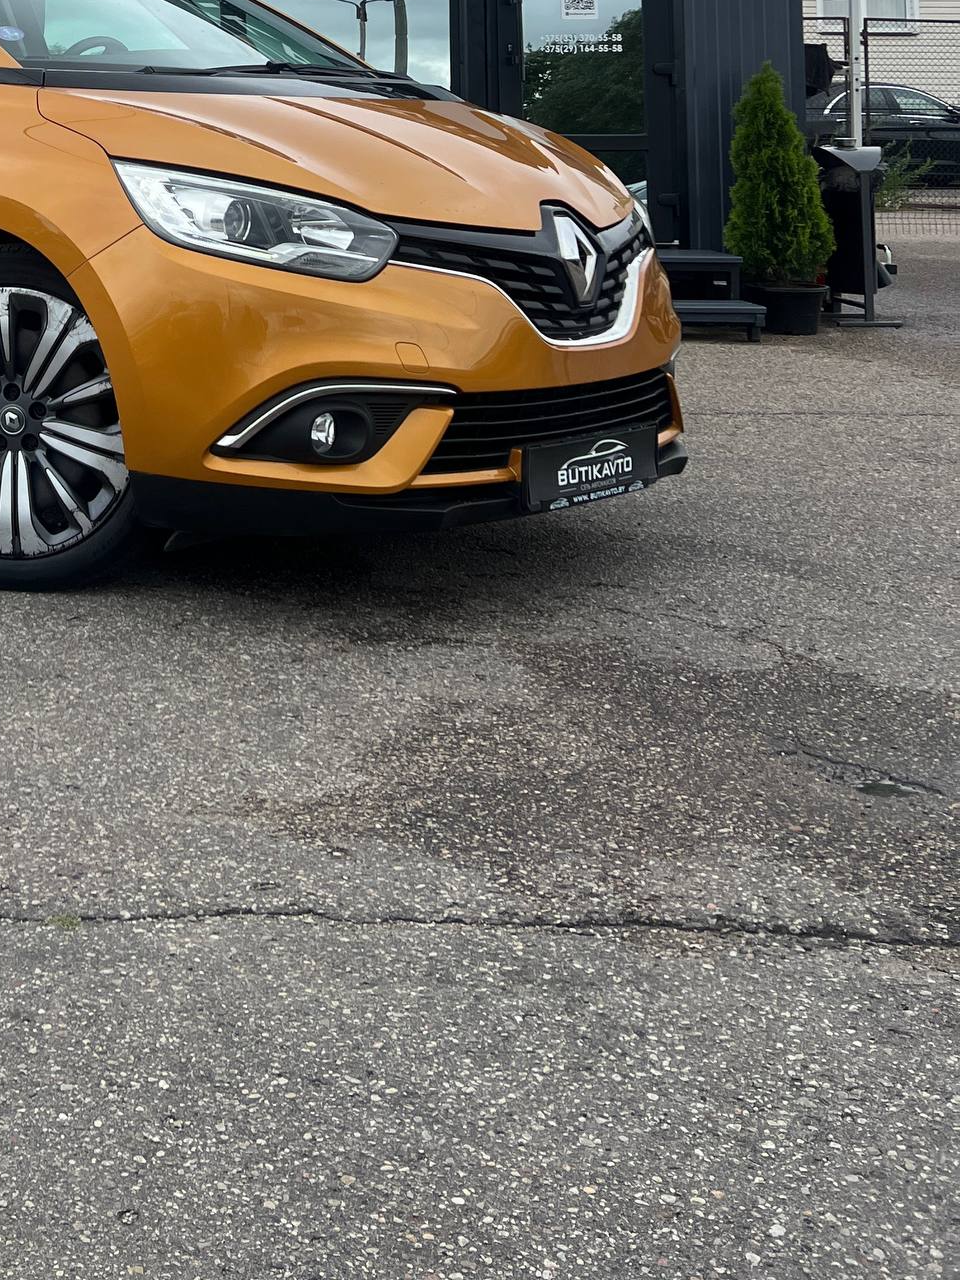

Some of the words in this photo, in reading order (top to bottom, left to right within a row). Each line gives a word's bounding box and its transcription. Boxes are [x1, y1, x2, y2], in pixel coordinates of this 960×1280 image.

[541, 44, 577, 55] +375(29)
[580, 44, 623, 53] 164-55-58
[557, 456, 632, 486] BUTIKAVTO
